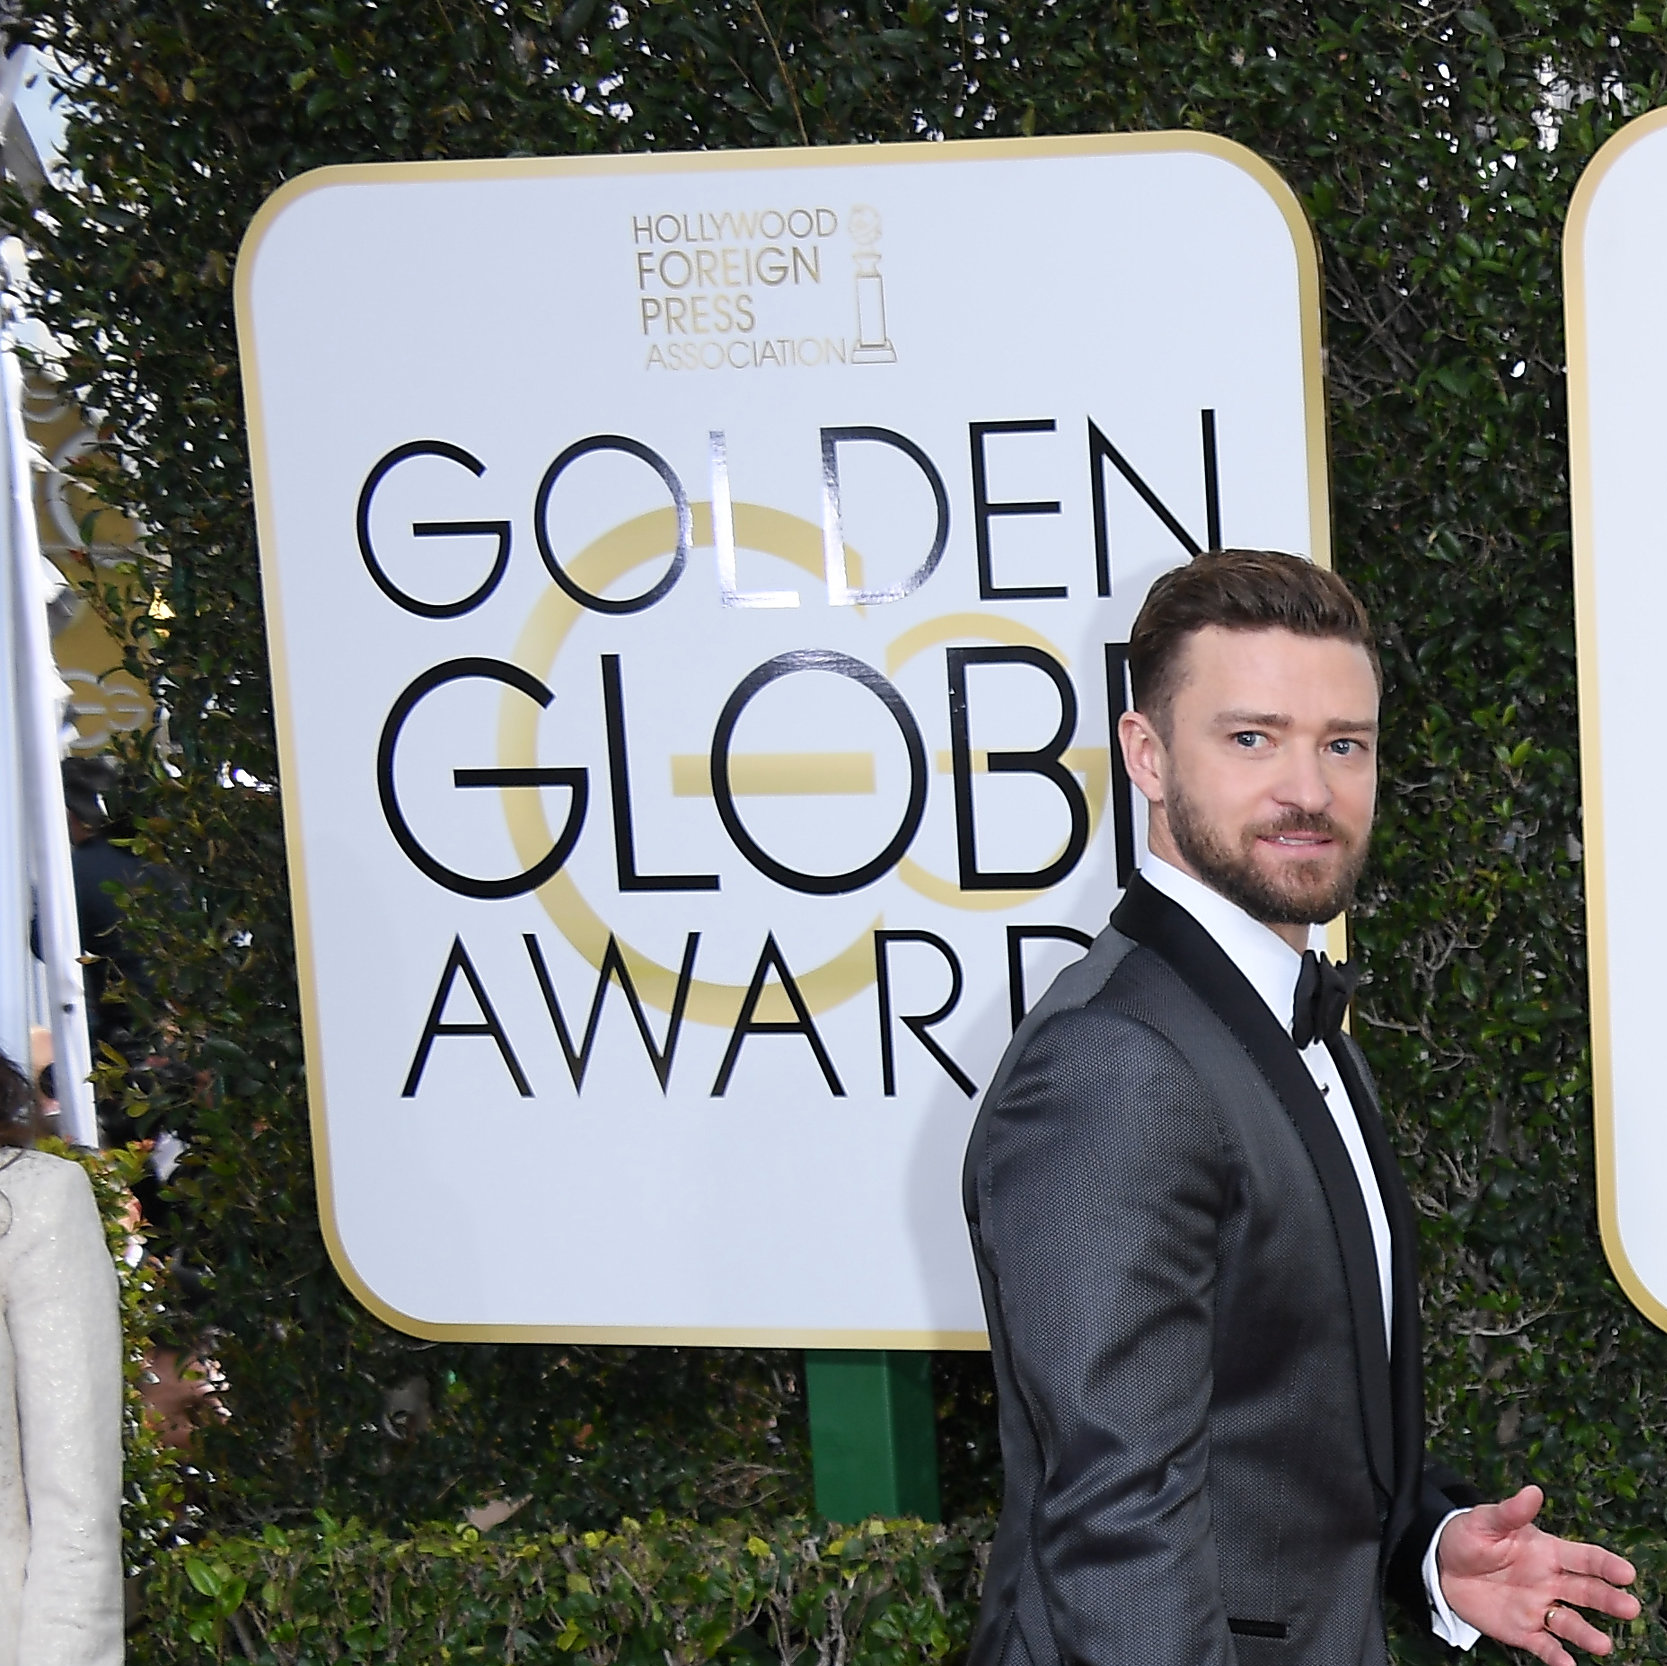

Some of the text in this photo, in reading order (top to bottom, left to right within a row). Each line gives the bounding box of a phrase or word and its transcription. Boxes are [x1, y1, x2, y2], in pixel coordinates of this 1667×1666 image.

[633, 208, 838, 244] HOLLYWOOD
[636, 245, 821, 290] FOREIGN
[640, 294, 756, 335] PRESS
[646, 337, 847, 371] ASSOCIATION
[357, 409, 1222, 619] GOLDEN
[402, 924, 1096, 1099] AWAR
